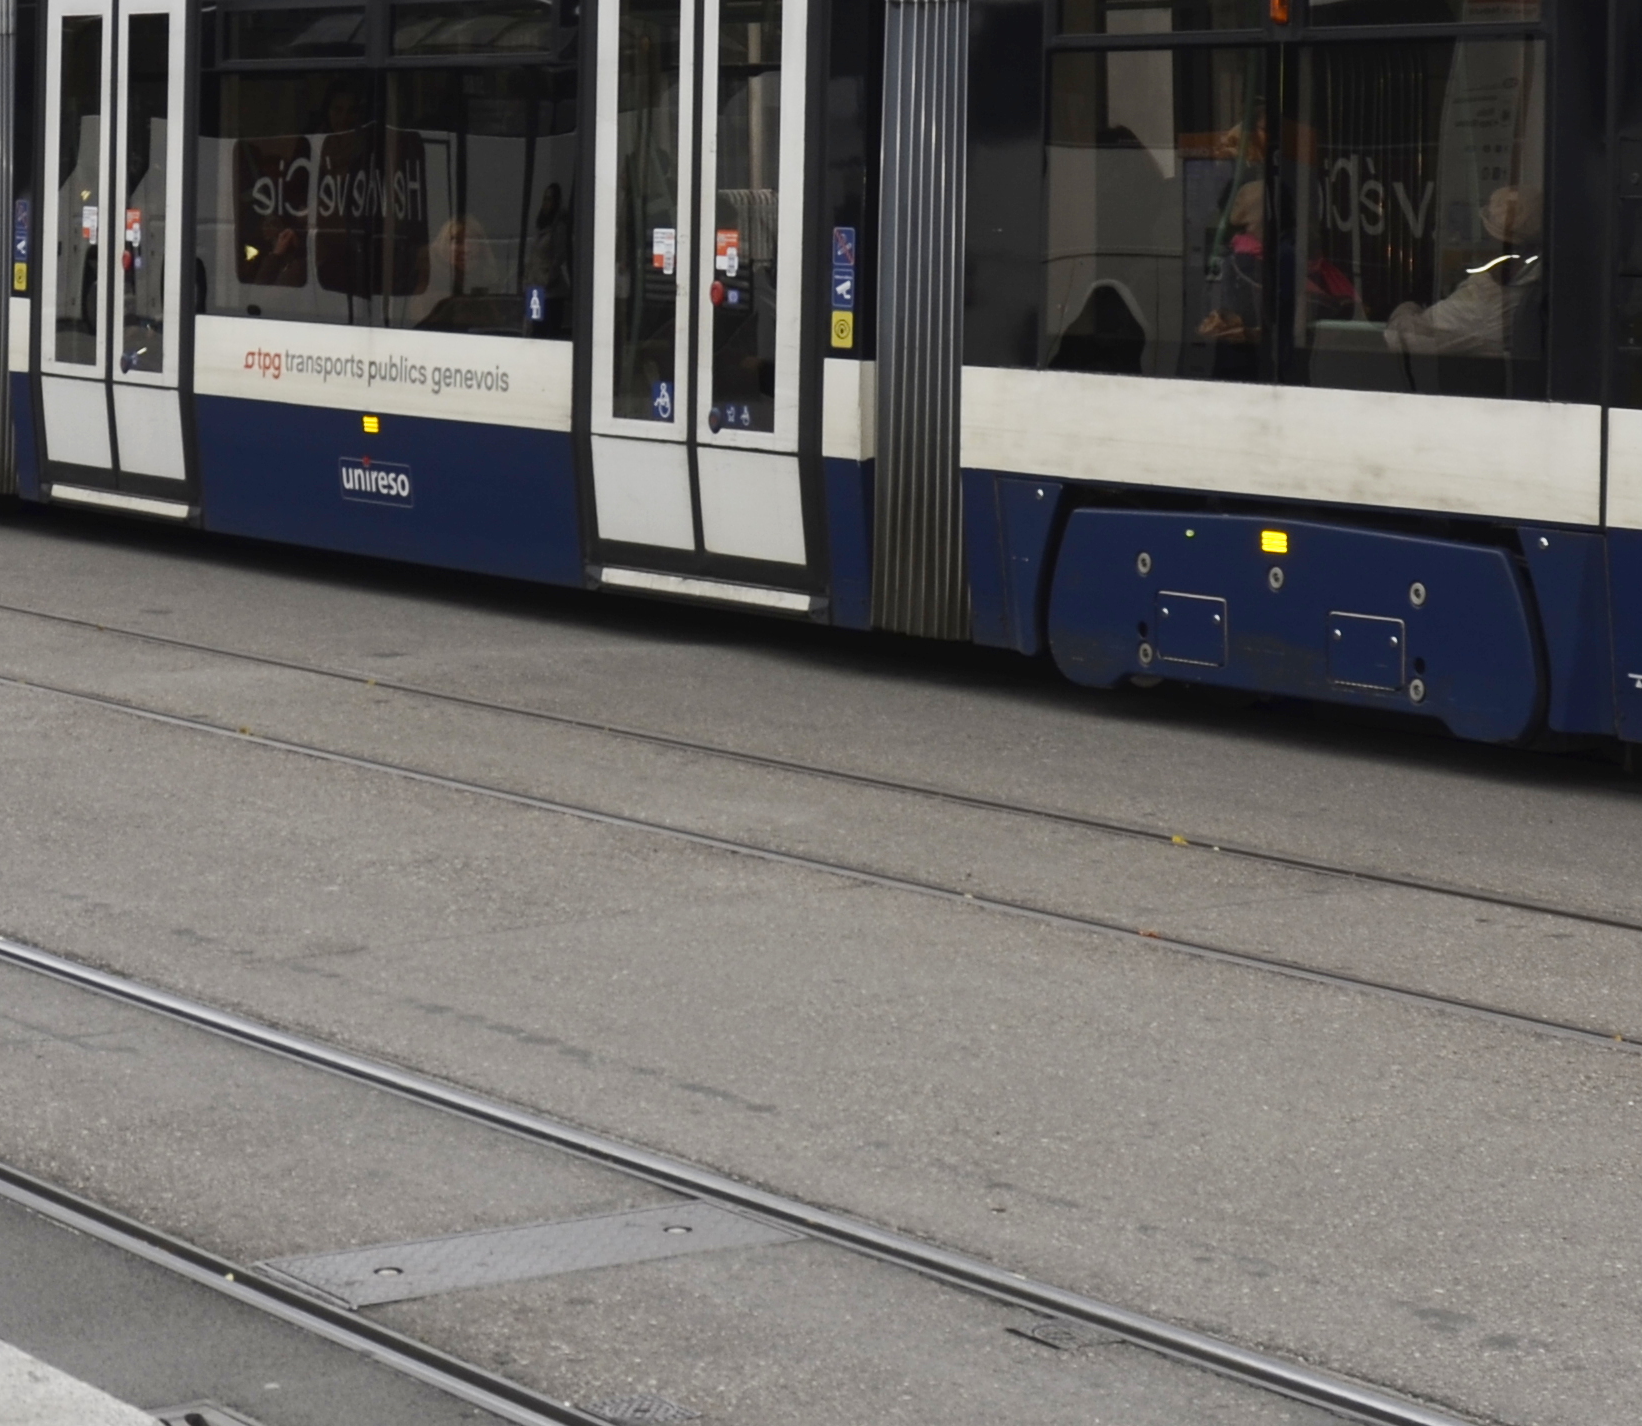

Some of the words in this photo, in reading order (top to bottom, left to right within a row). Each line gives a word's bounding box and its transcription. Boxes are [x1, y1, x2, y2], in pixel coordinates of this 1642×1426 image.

[285, 350, 364, 383] transports
[368, 355, 427, 387] publics
[432, 365, 510, 394] genevois
[341, 460, 410, 498] unireso
